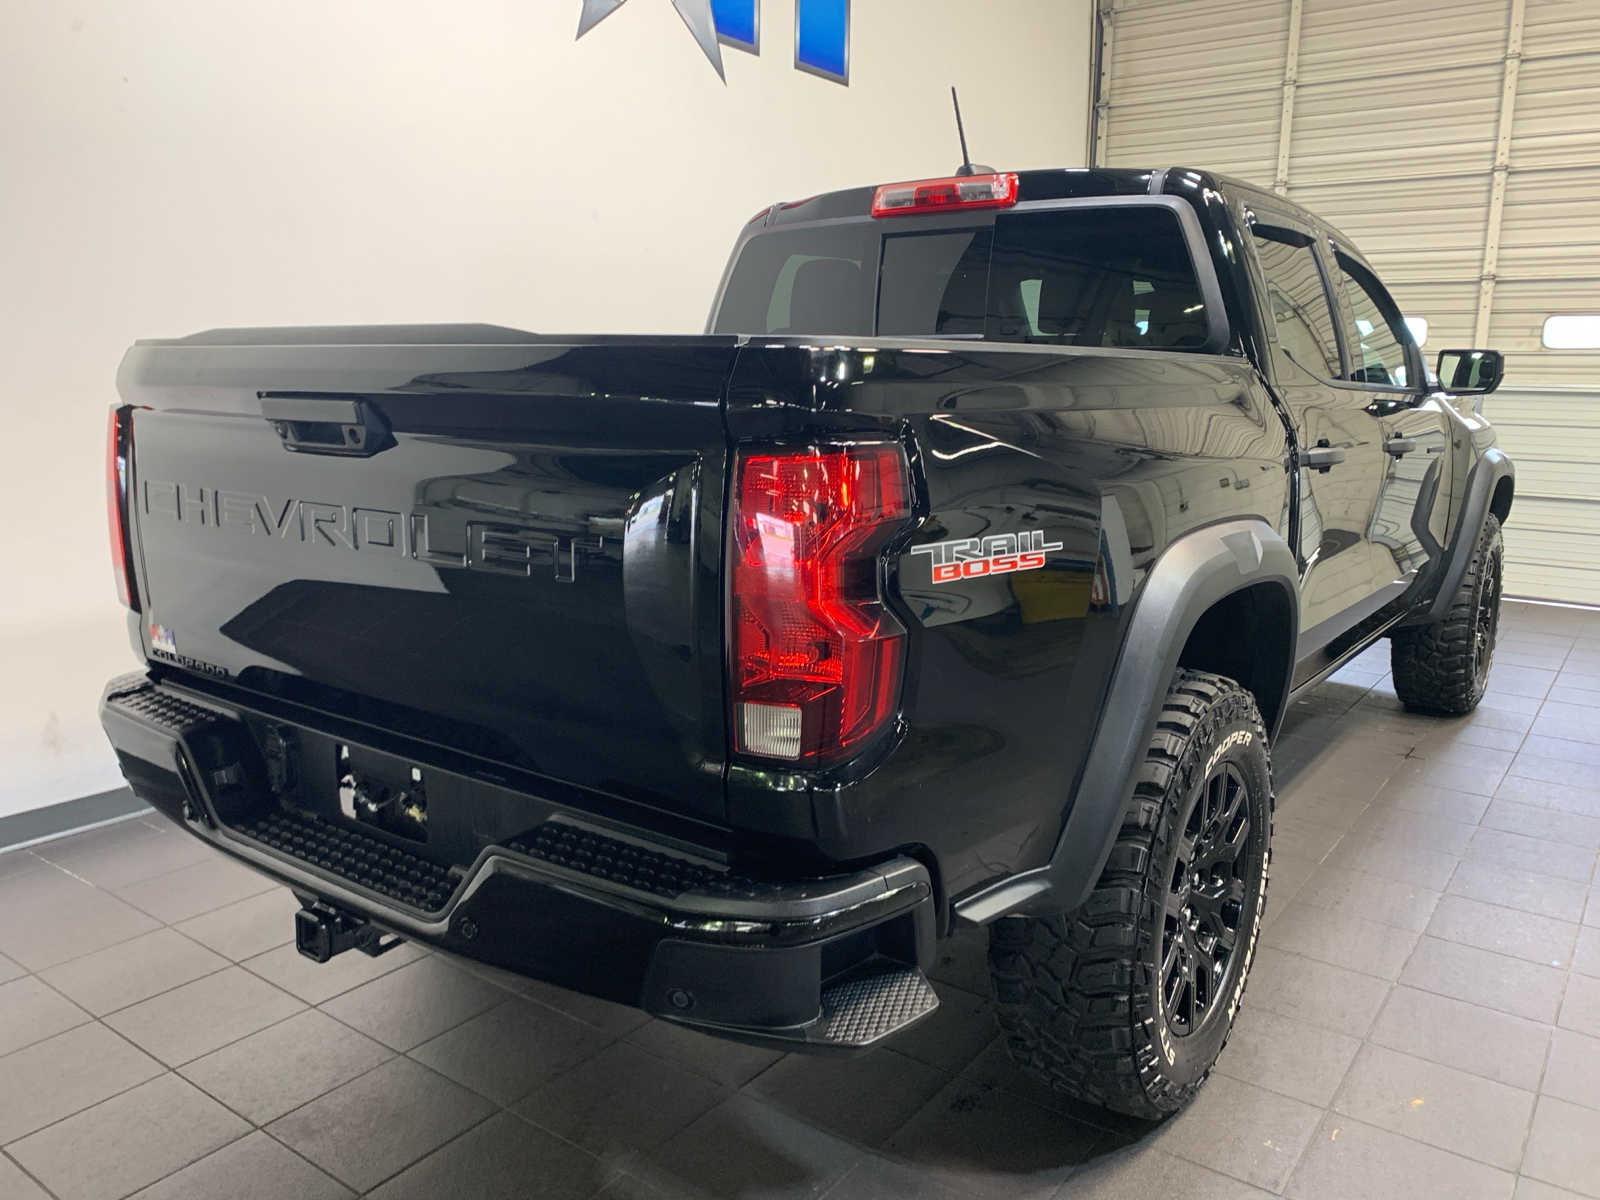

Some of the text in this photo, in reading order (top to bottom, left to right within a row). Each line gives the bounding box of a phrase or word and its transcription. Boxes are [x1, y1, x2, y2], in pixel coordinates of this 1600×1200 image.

[143, 479, 603, 583] CHEVROLET
[911, 530, 1063, 565] TRAIL
[932, 552, 1045, 584] BOSS
[1204, 730, 1252, 780] COOPER
